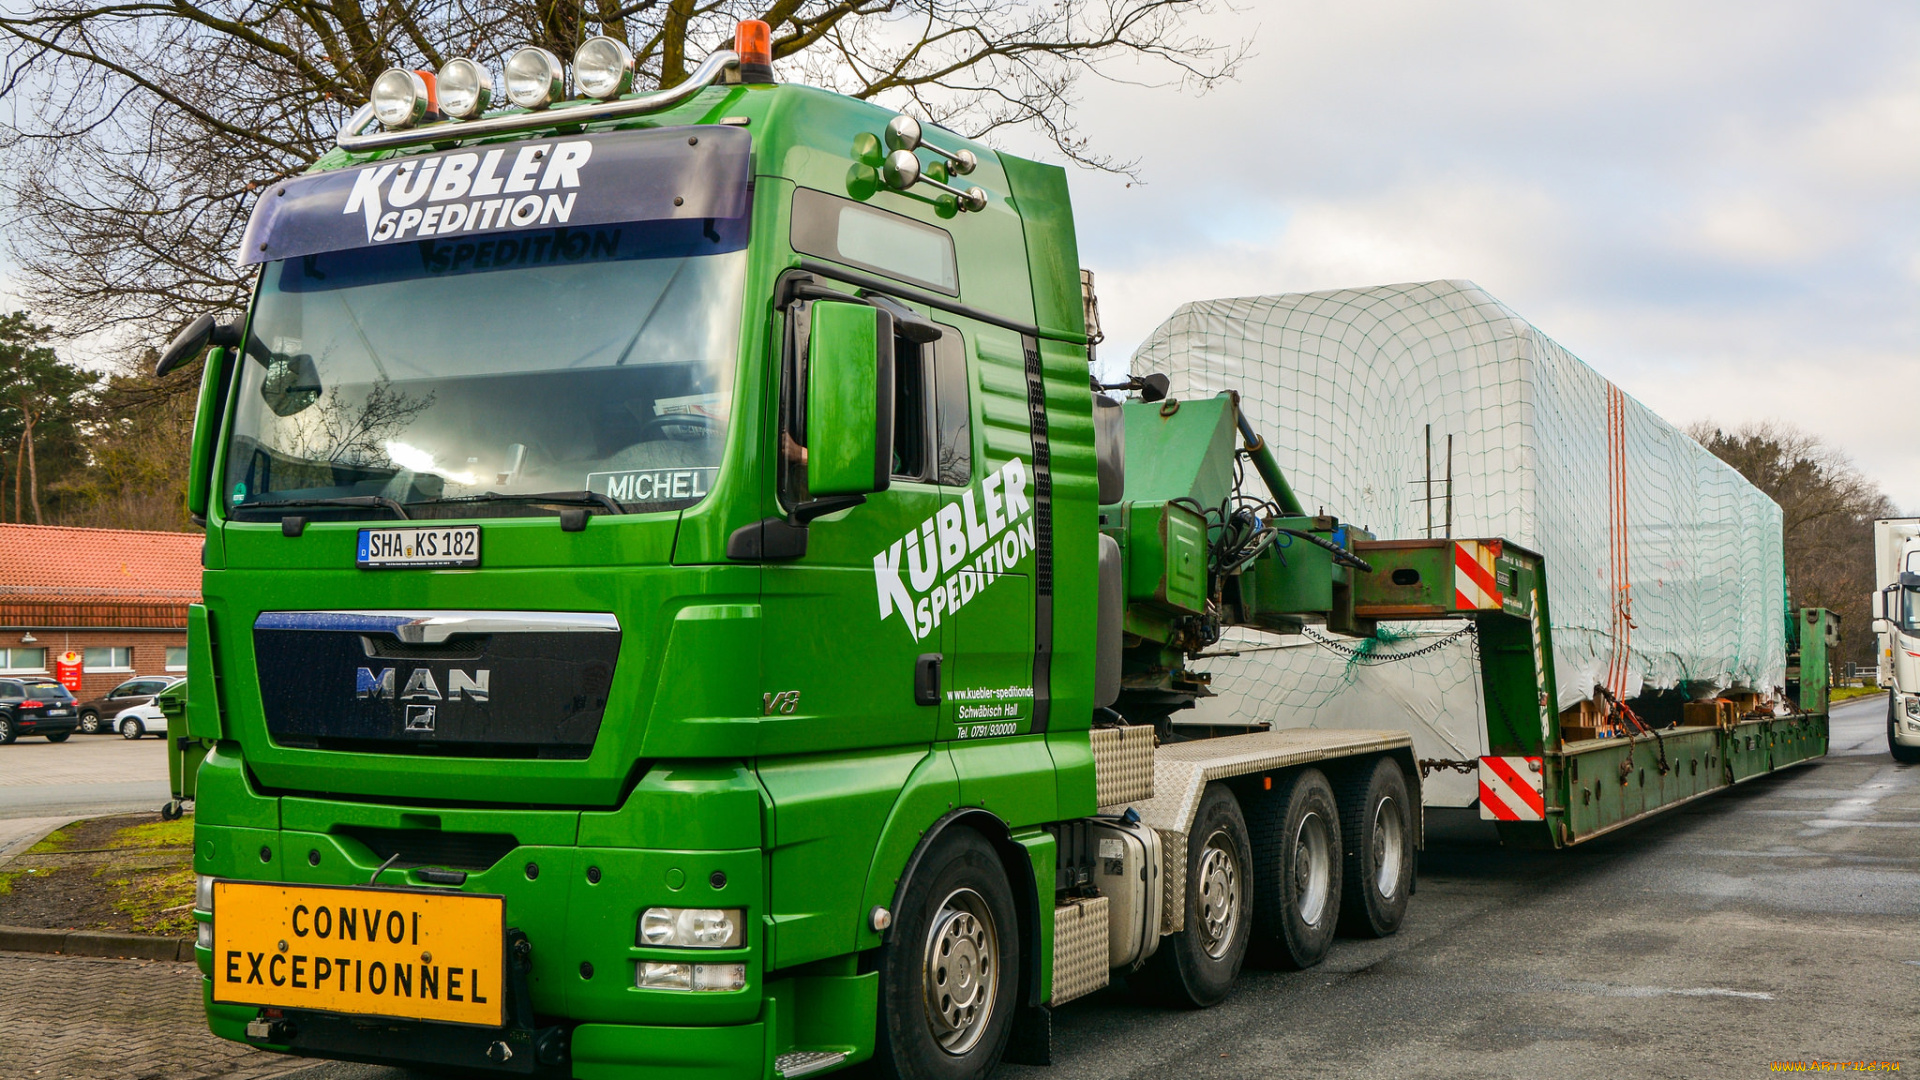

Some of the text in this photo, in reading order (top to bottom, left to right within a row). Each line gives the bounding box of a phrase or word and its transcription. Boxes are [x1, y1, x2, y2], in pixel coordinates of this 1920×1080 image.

[343, 140, 593, 244] KÜBLER
[373, 192, 577, 242] SPEDITION
[607, 471, 707, 500] MICHEL
[361, 531, 475, 557] D SHA KS 182
[873, 457, 1031, 644] KÜBLER
[917, 516, 1036, 638] SPEDITION
[356, 667, 490, 701] MAN
[763, 690, 800, 716] V8
[959, 703, 1018, 719] Schwäbisch Hall
[292, 904, 419, 945] CONVOI
[226, 951, 487, 1004] EXCEPTIONNEL
